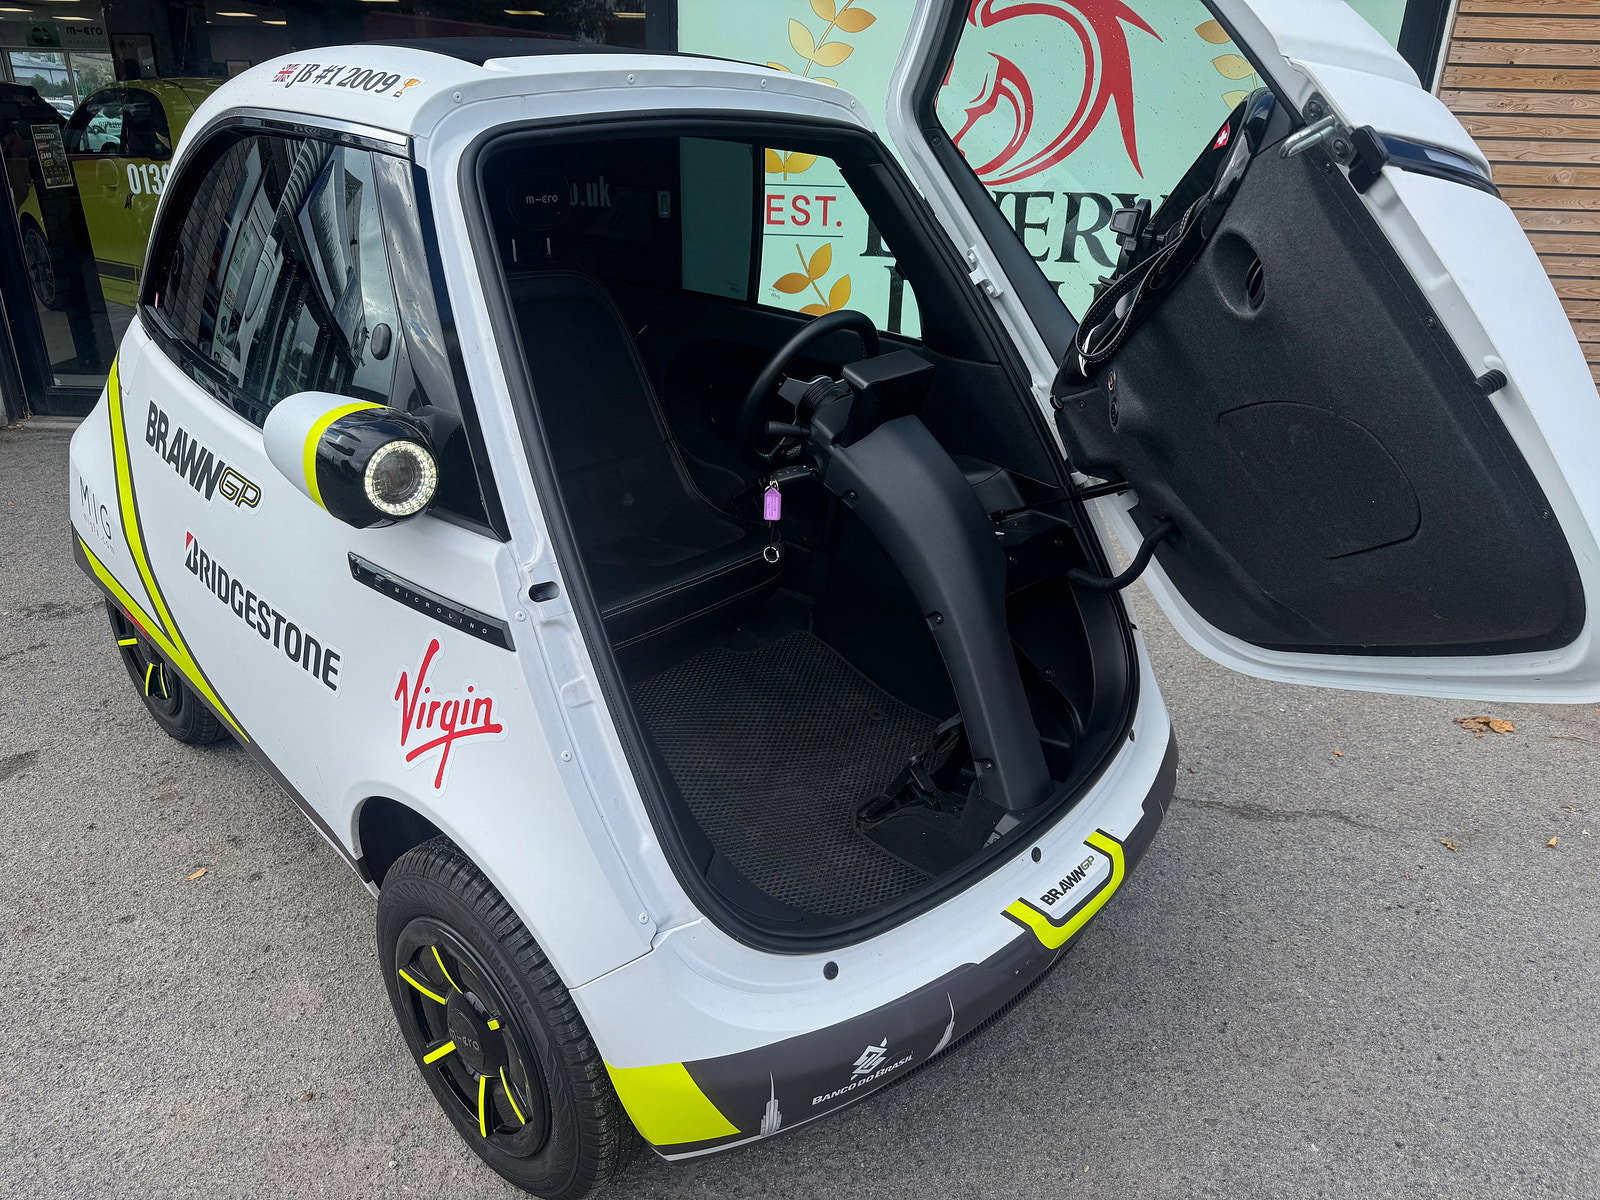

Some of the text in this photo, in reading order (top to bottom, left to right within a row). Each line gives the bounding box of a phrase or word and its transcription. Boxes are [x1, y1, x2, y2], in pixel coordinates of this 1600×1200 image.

[284, 63, 401, 93] JB #1 2009
[765, 194, 843, 228] EST.
[184, 531, 341, 692] BRIDGESTONE
[394, 586, 488, 635] MICROLINO
[394, 638, 503, 789] Virgin
[811, 1054, 914, 1106] BANCO DO BRASIL
